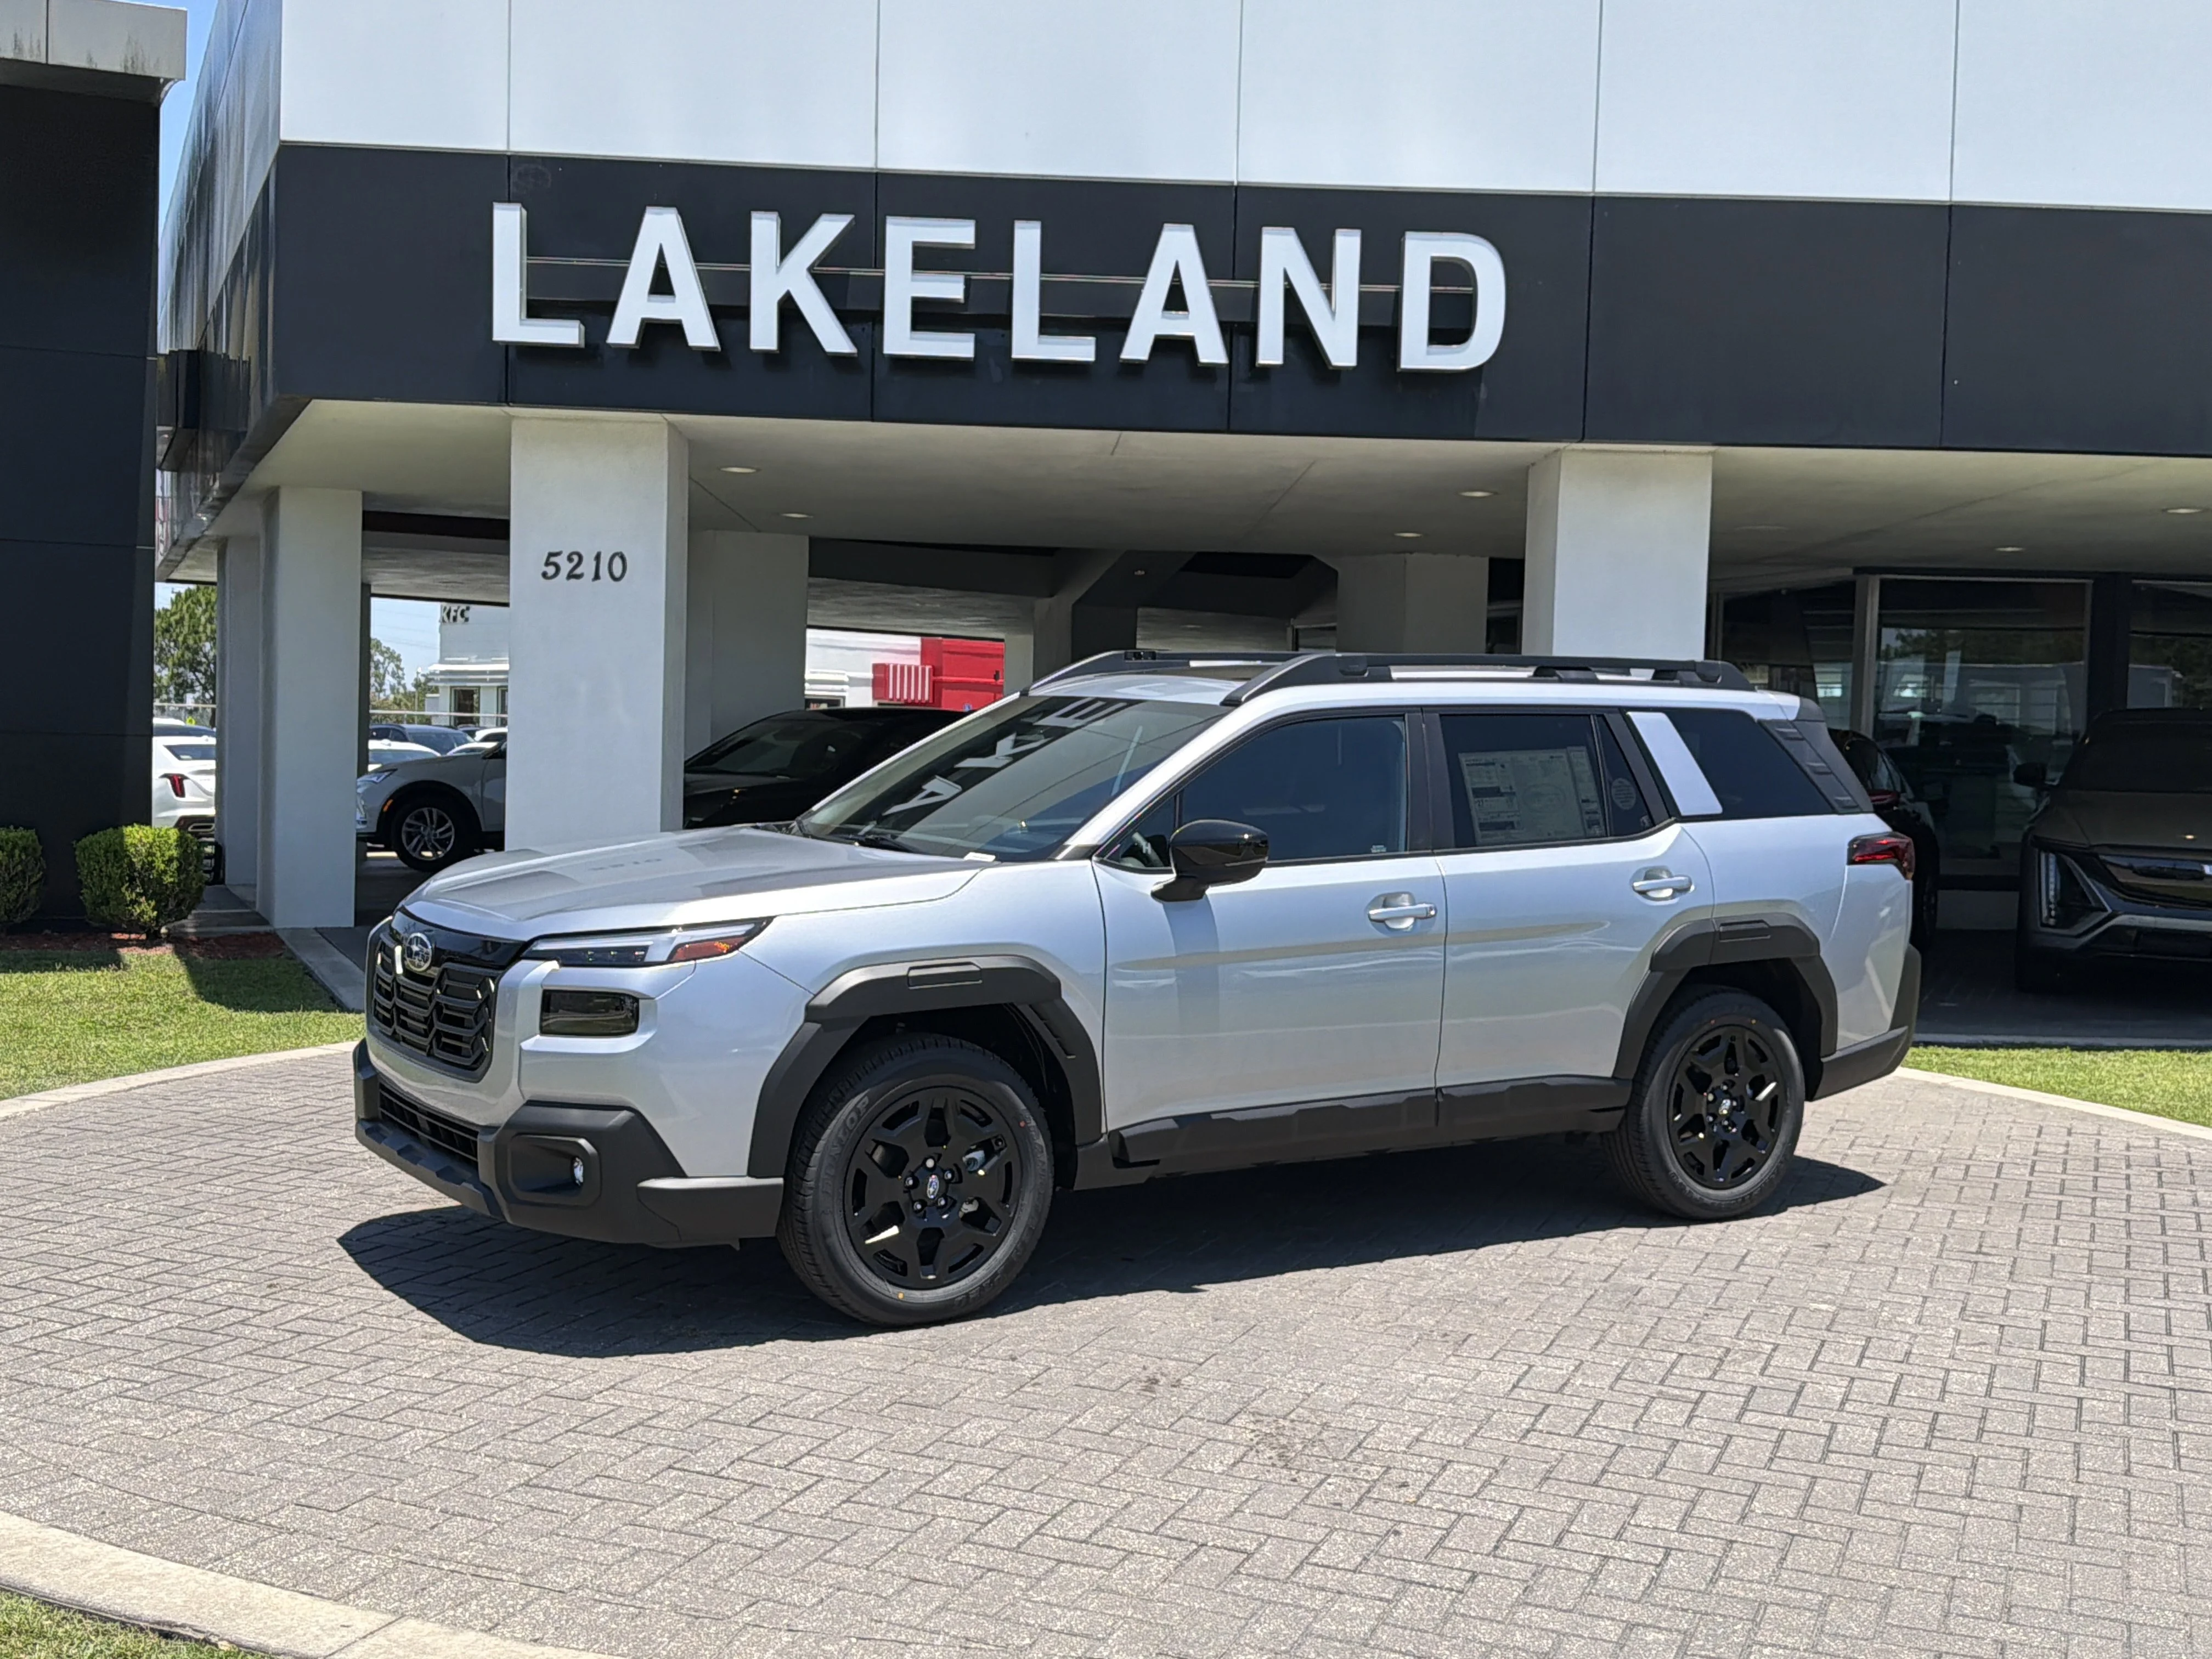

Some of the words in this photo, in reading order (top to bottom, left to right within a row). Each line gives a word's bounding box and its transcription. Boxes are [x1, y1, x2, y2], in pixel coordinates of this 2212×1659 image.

[492, 202, 1507, 373] LAKELAND
[541, 550, 628, 582] 5210
[441, 605, 471, 623] KFC
